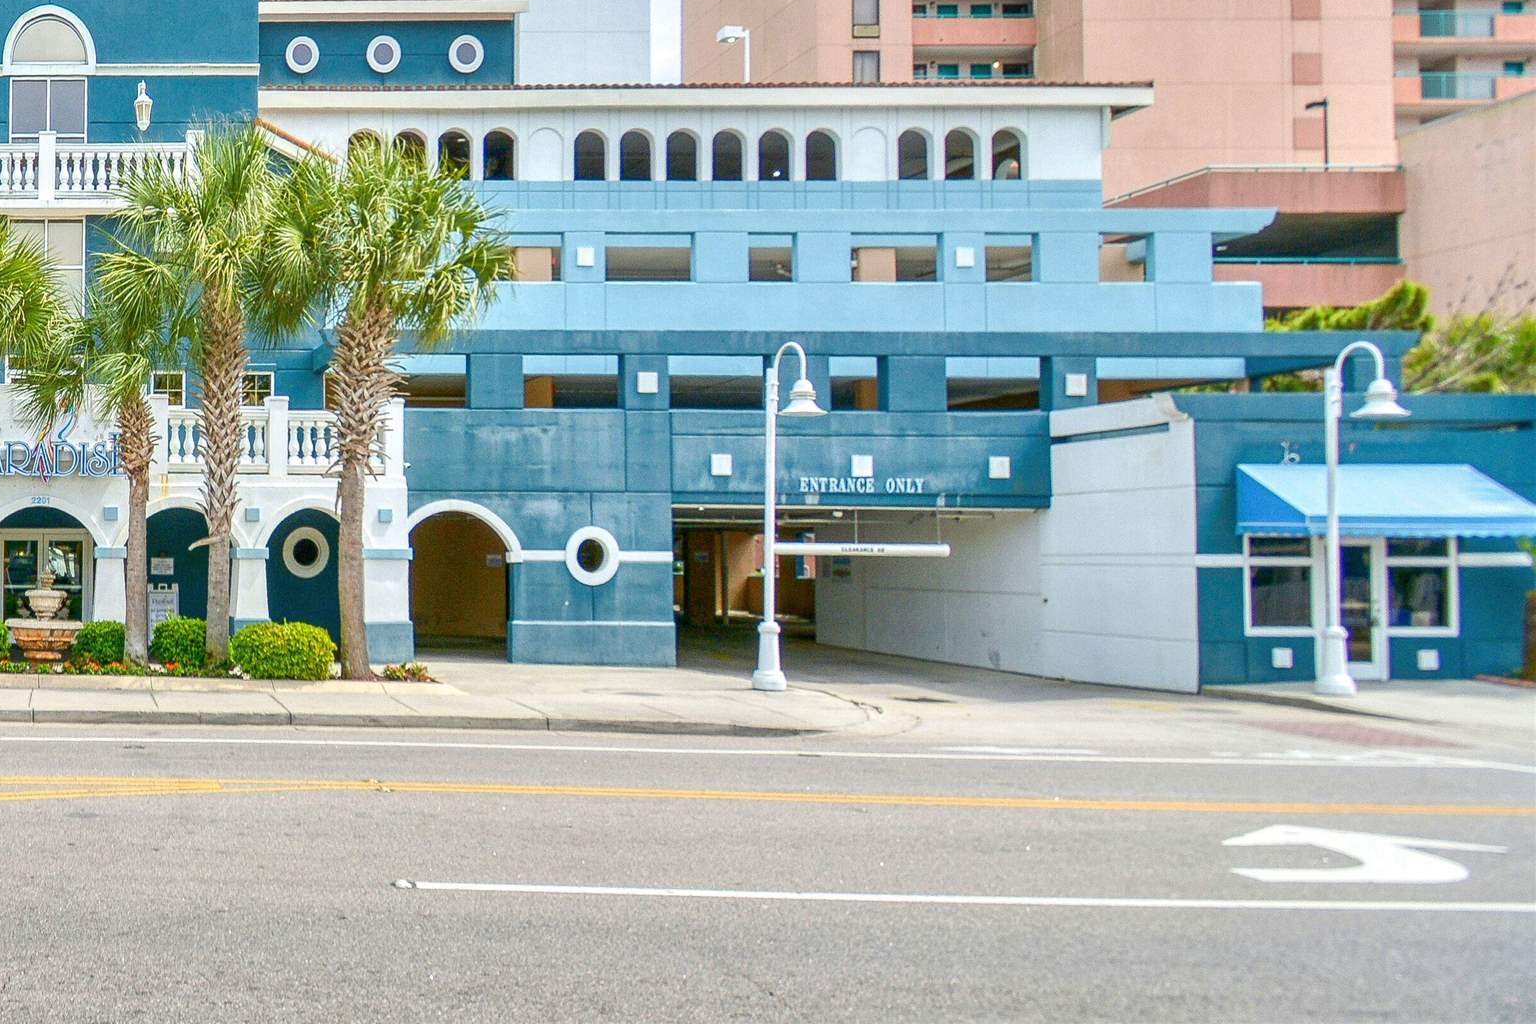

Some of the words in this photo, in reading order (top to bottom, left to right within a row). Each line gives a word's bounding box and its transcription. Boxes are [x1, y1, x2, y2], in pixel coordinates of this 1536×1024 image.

[799, 477, 875, 493] ENTRANCE
[886, 478, 925, 493] ONLY
[31, 496, 50, 505] 2201
